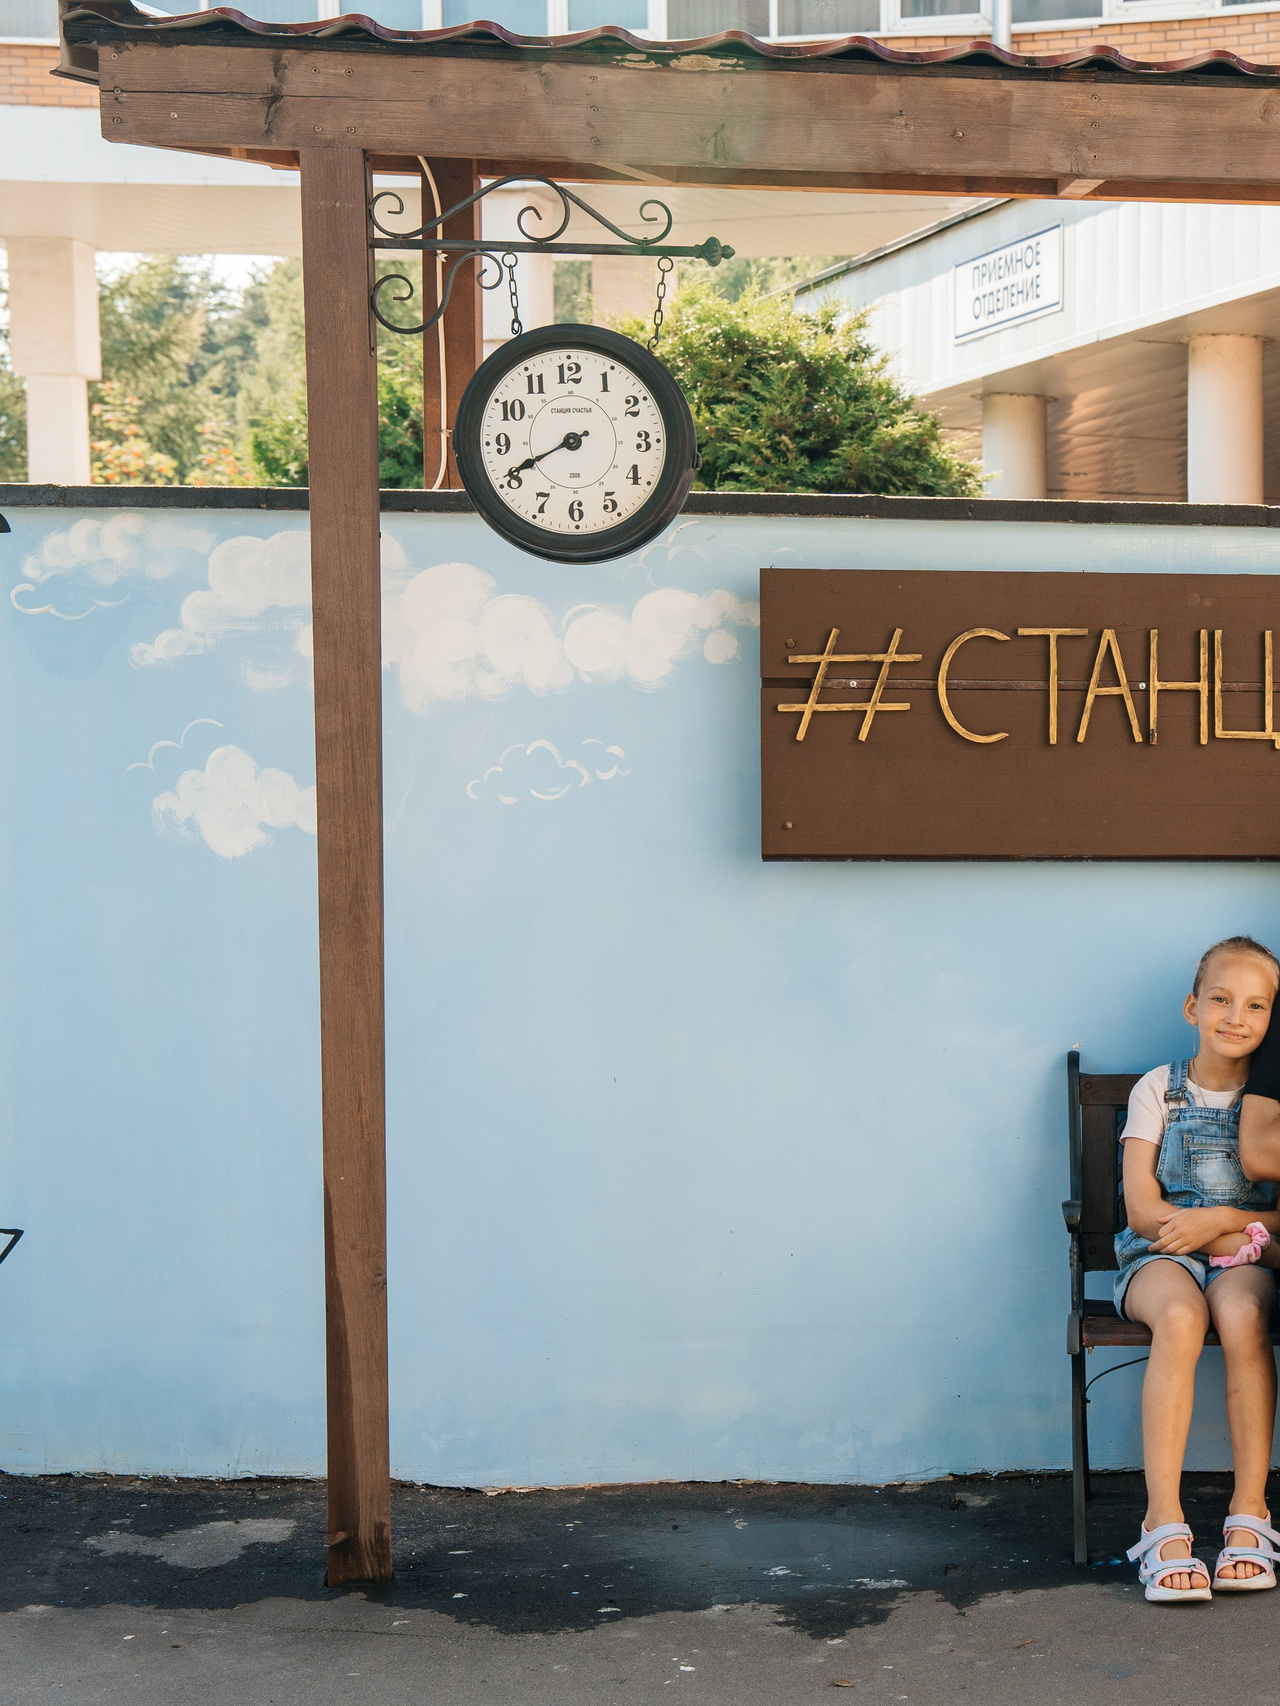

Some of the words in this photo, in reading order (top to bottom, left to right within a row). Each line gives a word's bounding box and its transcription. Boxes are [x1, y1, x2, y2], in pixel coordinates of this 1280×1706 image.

[972, 241, 1041, 290] ПРИЕМНОЕ
[972, 274, 1041, 320] ОТДЕЛЕНИЕ
[526, 373, 546, 394] 11
[557, 362, 583, 385] 12
[600, 371, 611, 392] 1
[500, 398, 526, 422] 10
[624, 395, 641, 418] 2
[495, 432, 511, 456] 9
[635, 430, 652, 453] 3
[506, 466, 523, 490] 8
[625, 463, 643, 486] 4
[535, 492, 550, 513] 7
[567, 499, 585, 523] 6
[602, 491, 618, 513] 5
